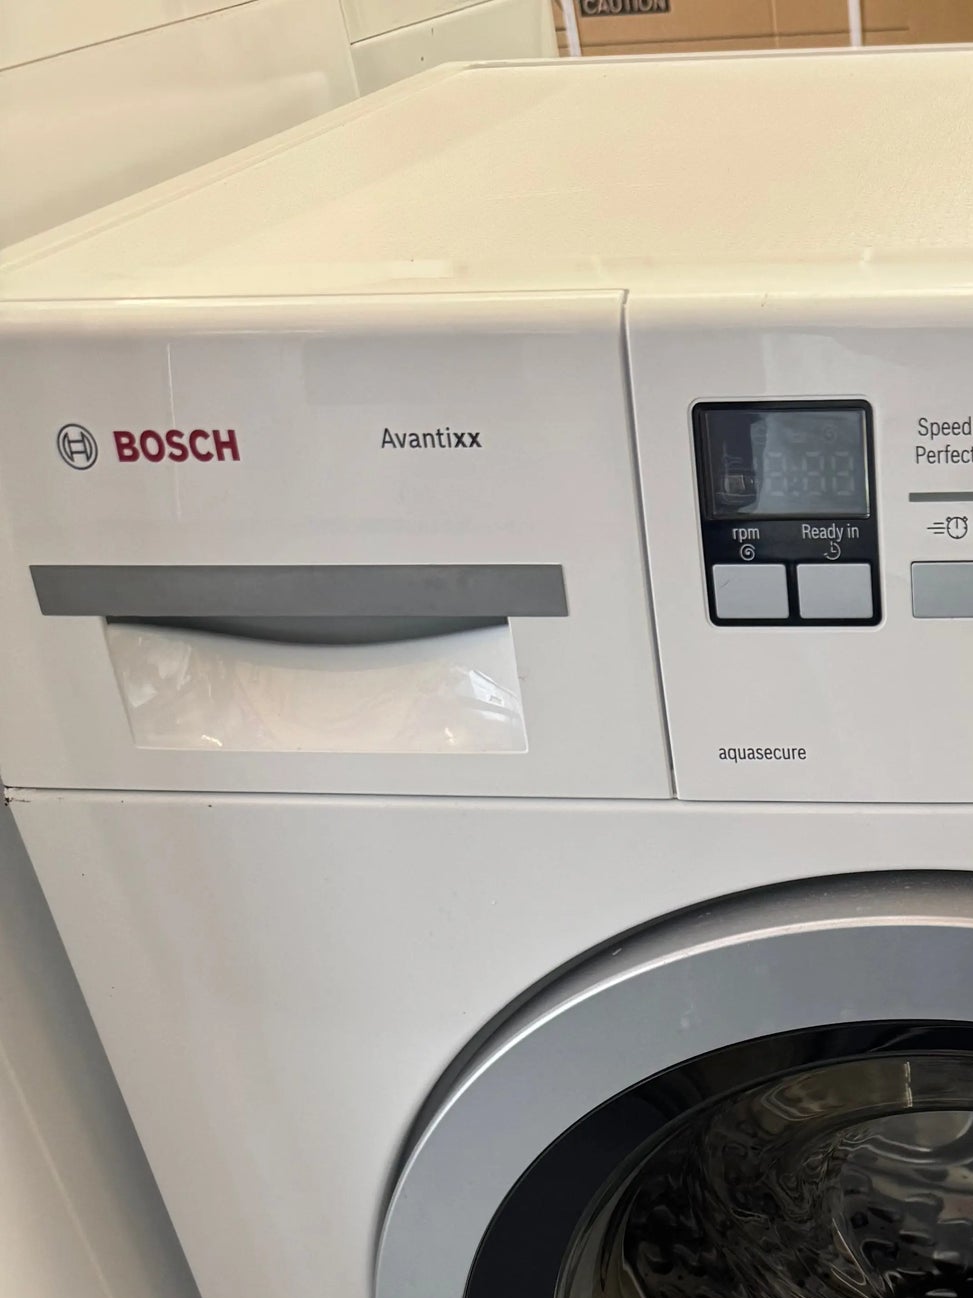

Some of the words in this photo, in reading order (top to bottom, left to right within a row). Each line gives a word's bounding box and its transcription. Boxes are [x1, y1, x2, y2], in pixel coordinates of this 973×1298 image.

[583, 0, 666, 14] CAUTION
[918, 417, 972, 438] Speed
[113, 429, 240, 463] BOSCH
[381, 427, 482, 449] Avantixx
[732, 527, 759, 542] rpm
[802, 523, 843, 542] Ready
[848, 524, 859, 538] in
[718, 746, 807, 762] aquasecure
